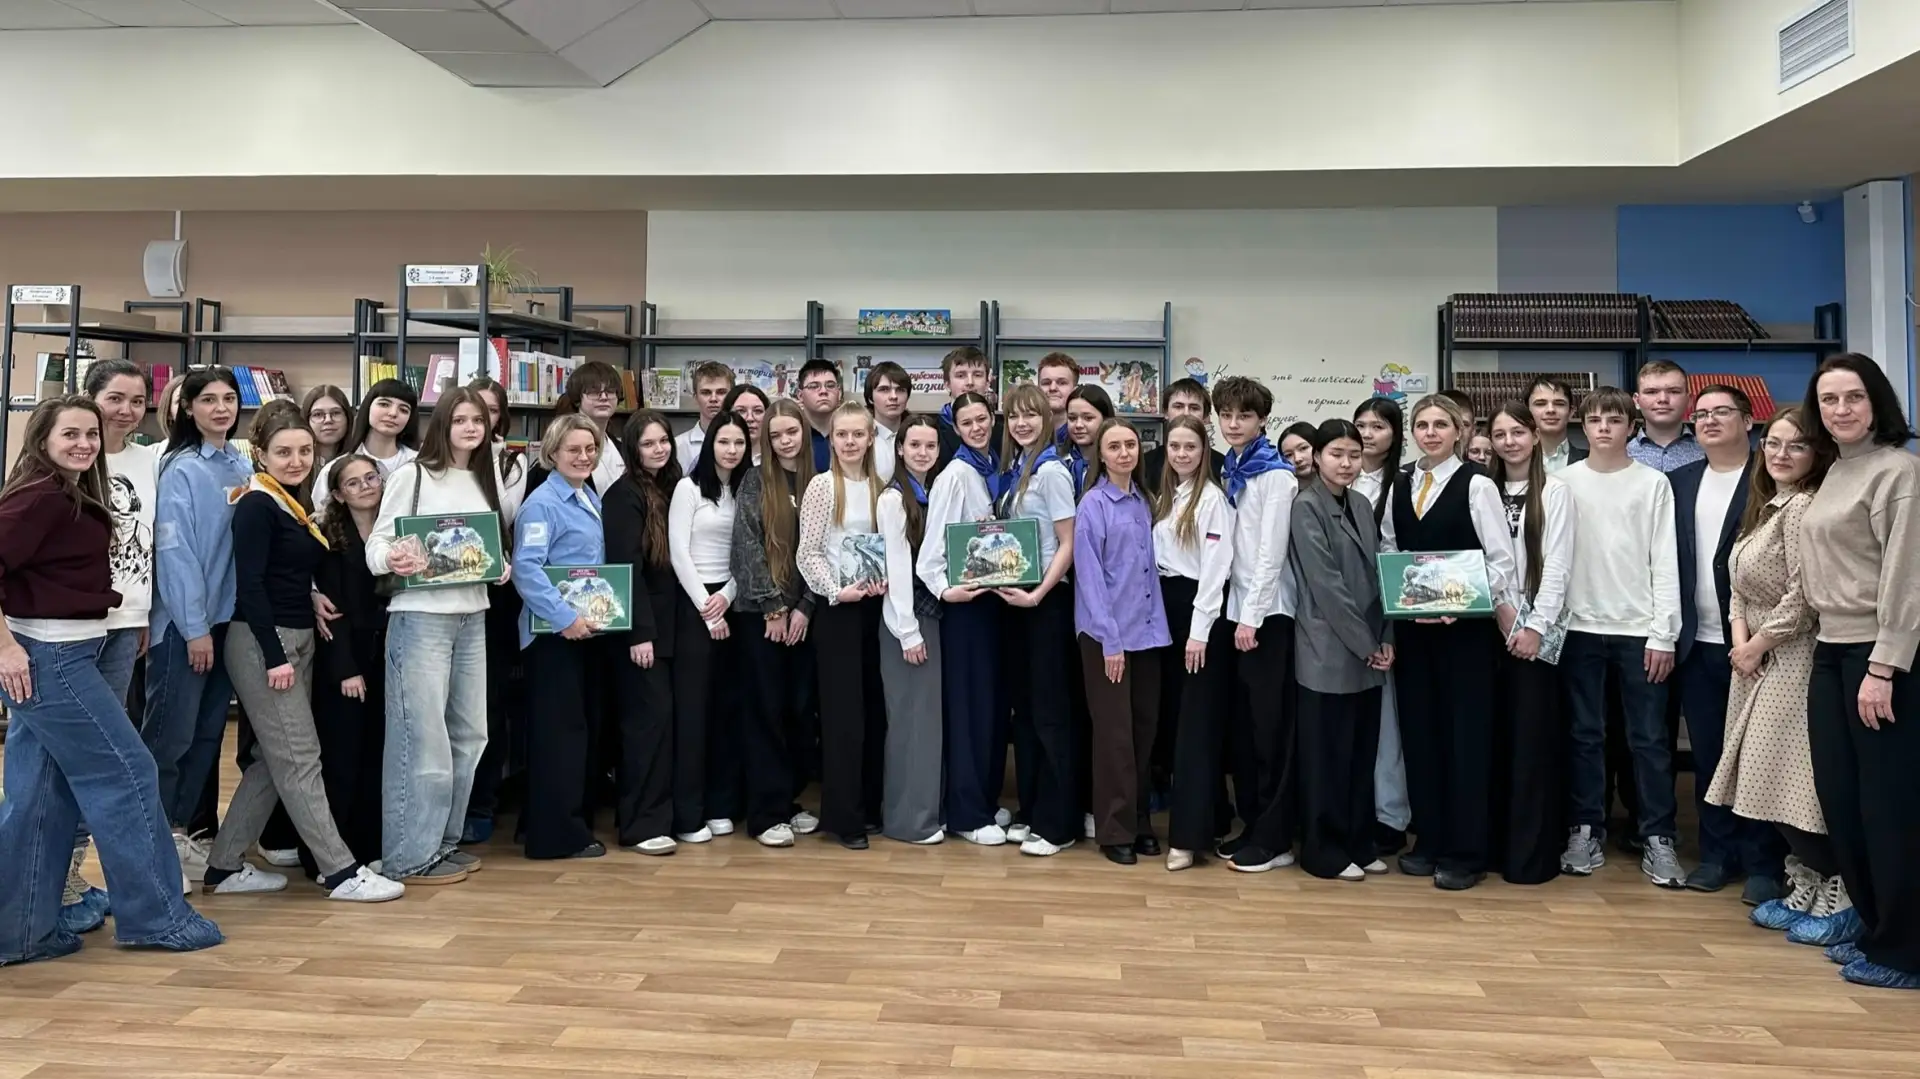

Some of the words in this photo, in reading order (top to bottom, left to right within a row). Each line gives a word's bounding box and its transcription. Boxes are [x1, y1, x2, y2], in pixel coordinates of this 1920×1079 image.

[1271, 374, 1293, 382] это
[1299, 373, 1368, 385] магический
[911, 383, 945, 393] казки
[1307, 398, 1351, 413] портал
